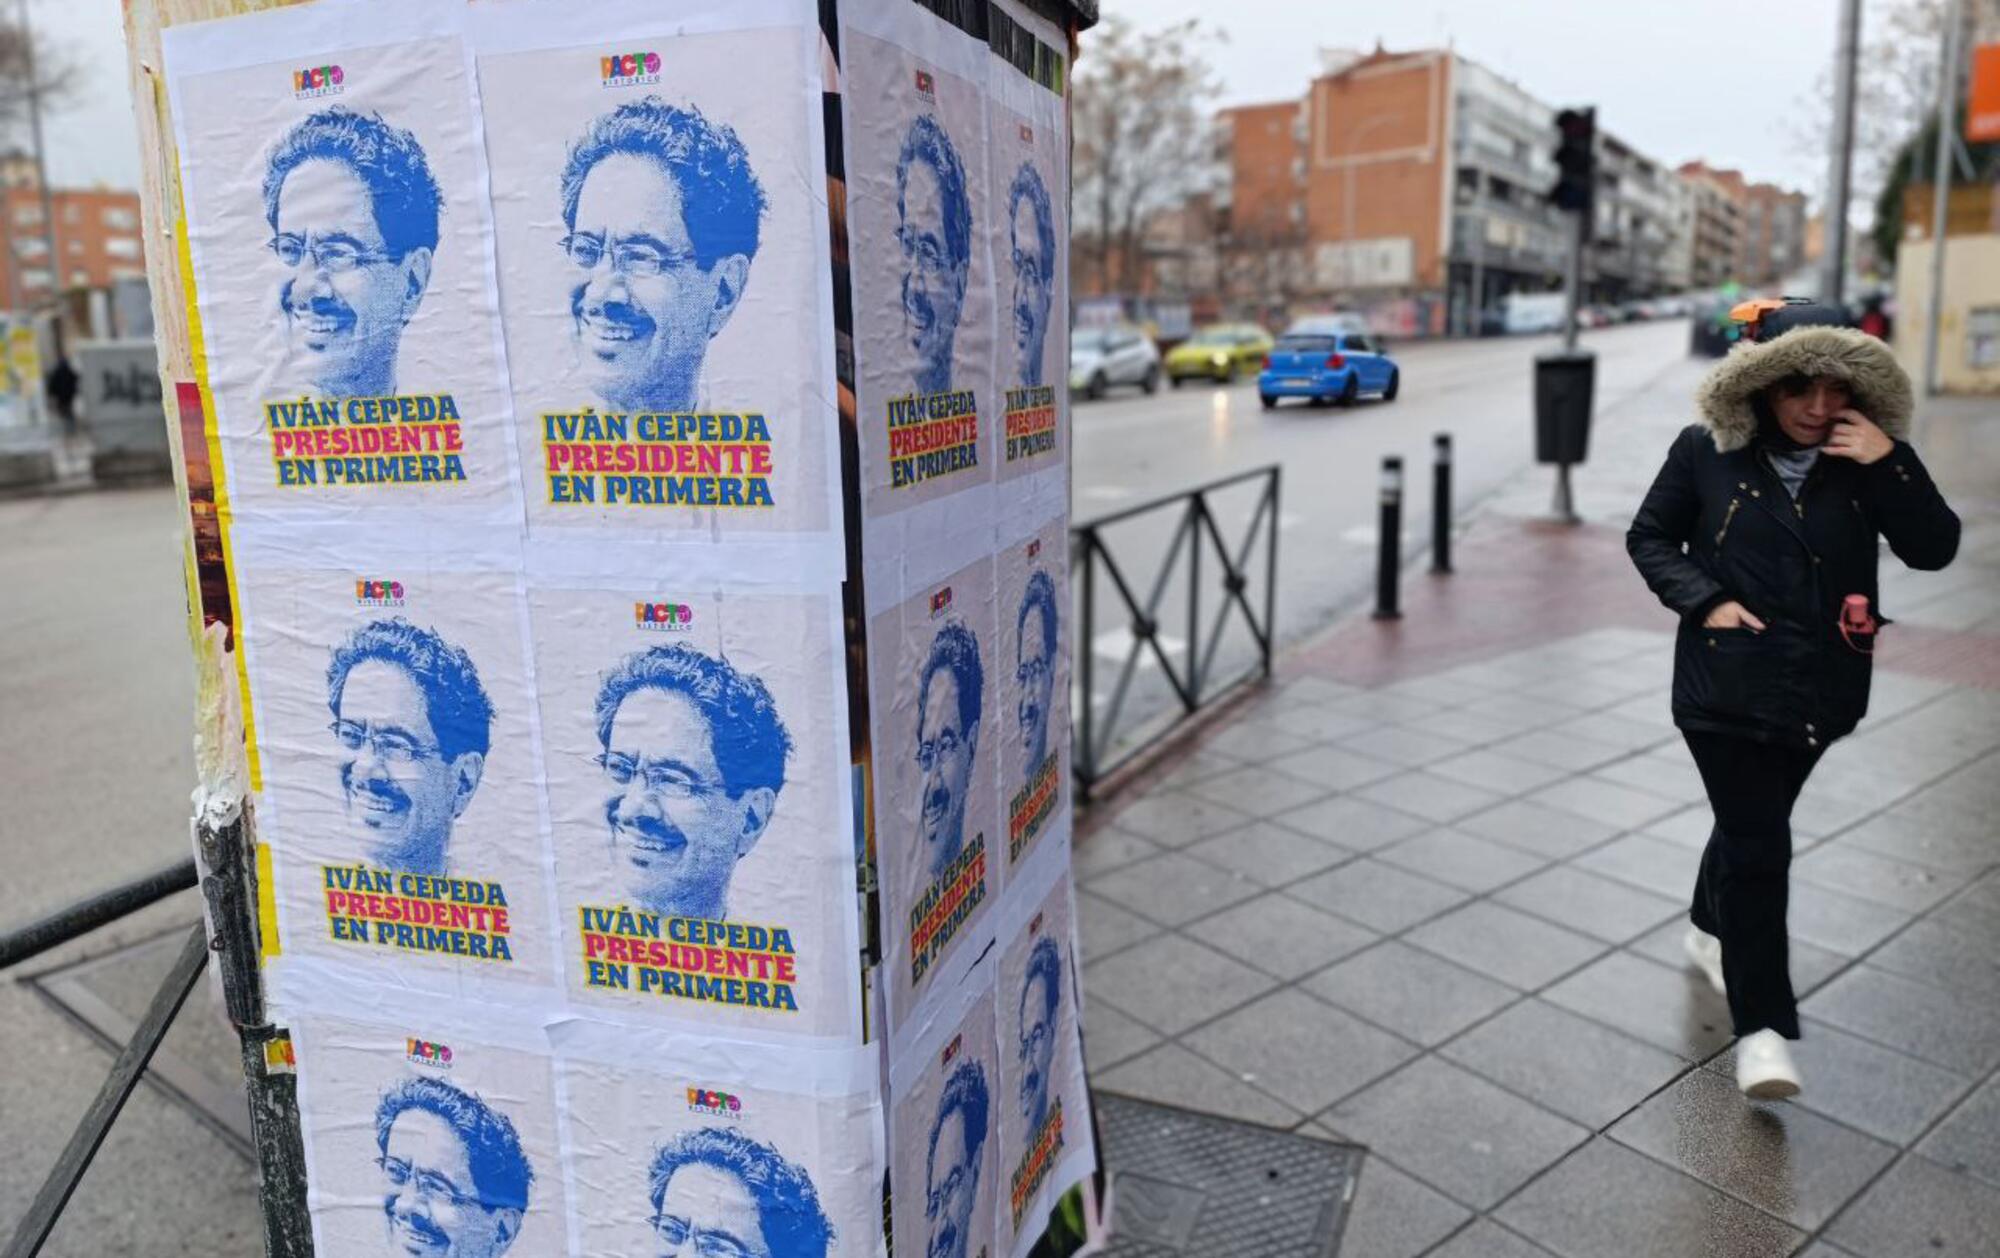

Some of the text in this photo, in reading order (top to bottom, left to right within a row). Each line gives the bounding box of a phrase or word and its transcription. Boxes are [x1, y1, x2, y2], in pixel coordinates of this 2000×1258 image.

[293, 65, 344, 91] PACTO
[600, 53, 661, 79] PACTO
[267, 395, 460, 428] IVÁN CEPEDA
[544, 408, 773, 442] IVÁN CEPEDA
[888, 391, 976, 427] IVÁN CEPEDA
[272, 423, 464, 457] PRESIDENTE
[889, 415, 977, 458] PRESIDENTE
[278, 454, 467, 486] EN PRIMERA
[547, 444, 773, 473] PRESIDENTE
[891, 443, 977, 488] EN PRIMERA
[550, 475, 775, 506] EN PRIMERA
[356, 578, 404, 599] PACTO
[635, 602, 692, 624] PACTO
[323, 865, 508, 907] IVÁN CEPEDA
[327, 890, 510, 933] PRESIDENTE
[911, 853, 985, 961] PRESIDENTE
[332, 917, 512, 961] EN PRIMERA
[580, 906, 795, 954] IVÁN CEPEDA
[584, 933, 796, 982] PRESIDENTE
[912, 946, 929, 987] EN
[588, 960, 798, 1010] EN PRIMERA
[687, 1087, 741, 1111] PACTO
